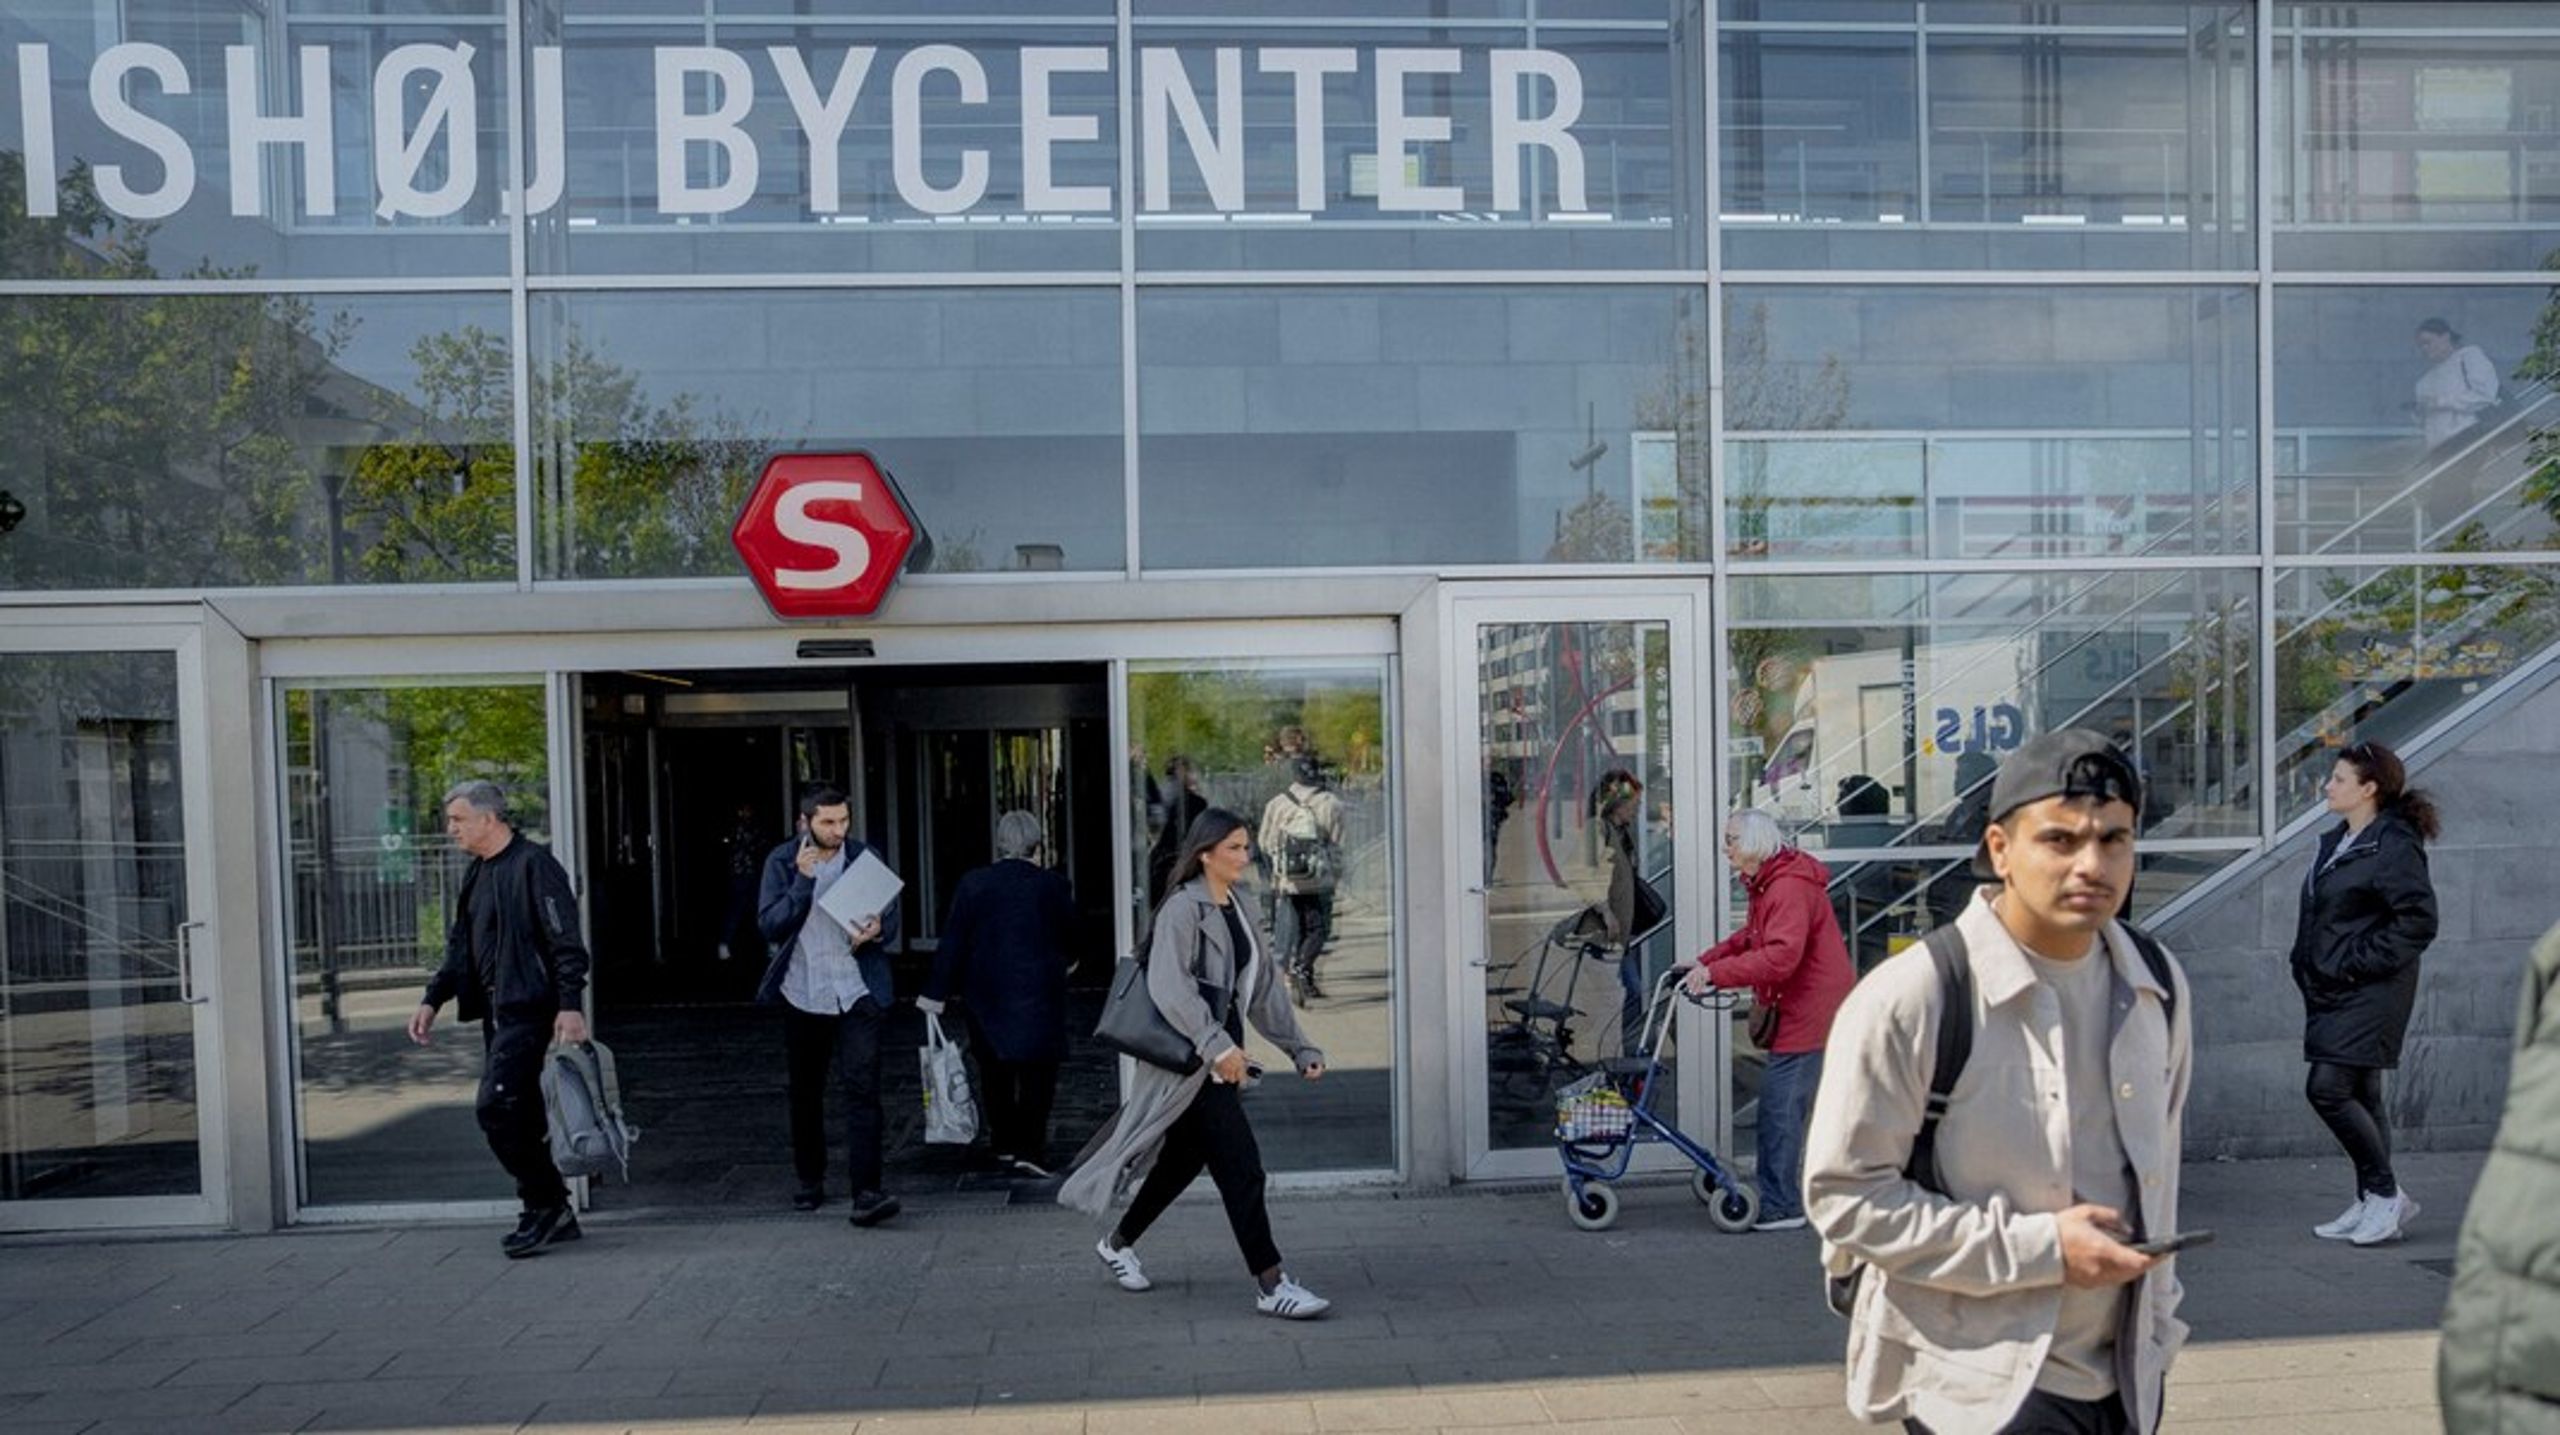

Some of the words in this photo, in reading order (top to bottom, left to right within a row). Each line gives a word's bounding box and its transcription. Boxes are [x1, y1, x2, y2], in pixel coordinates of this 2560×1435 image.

[18, 42, 565, 220] ISHØJ
[655, 46, 1588, 214] BYCENTER
[774, 482, 869, 590] S
